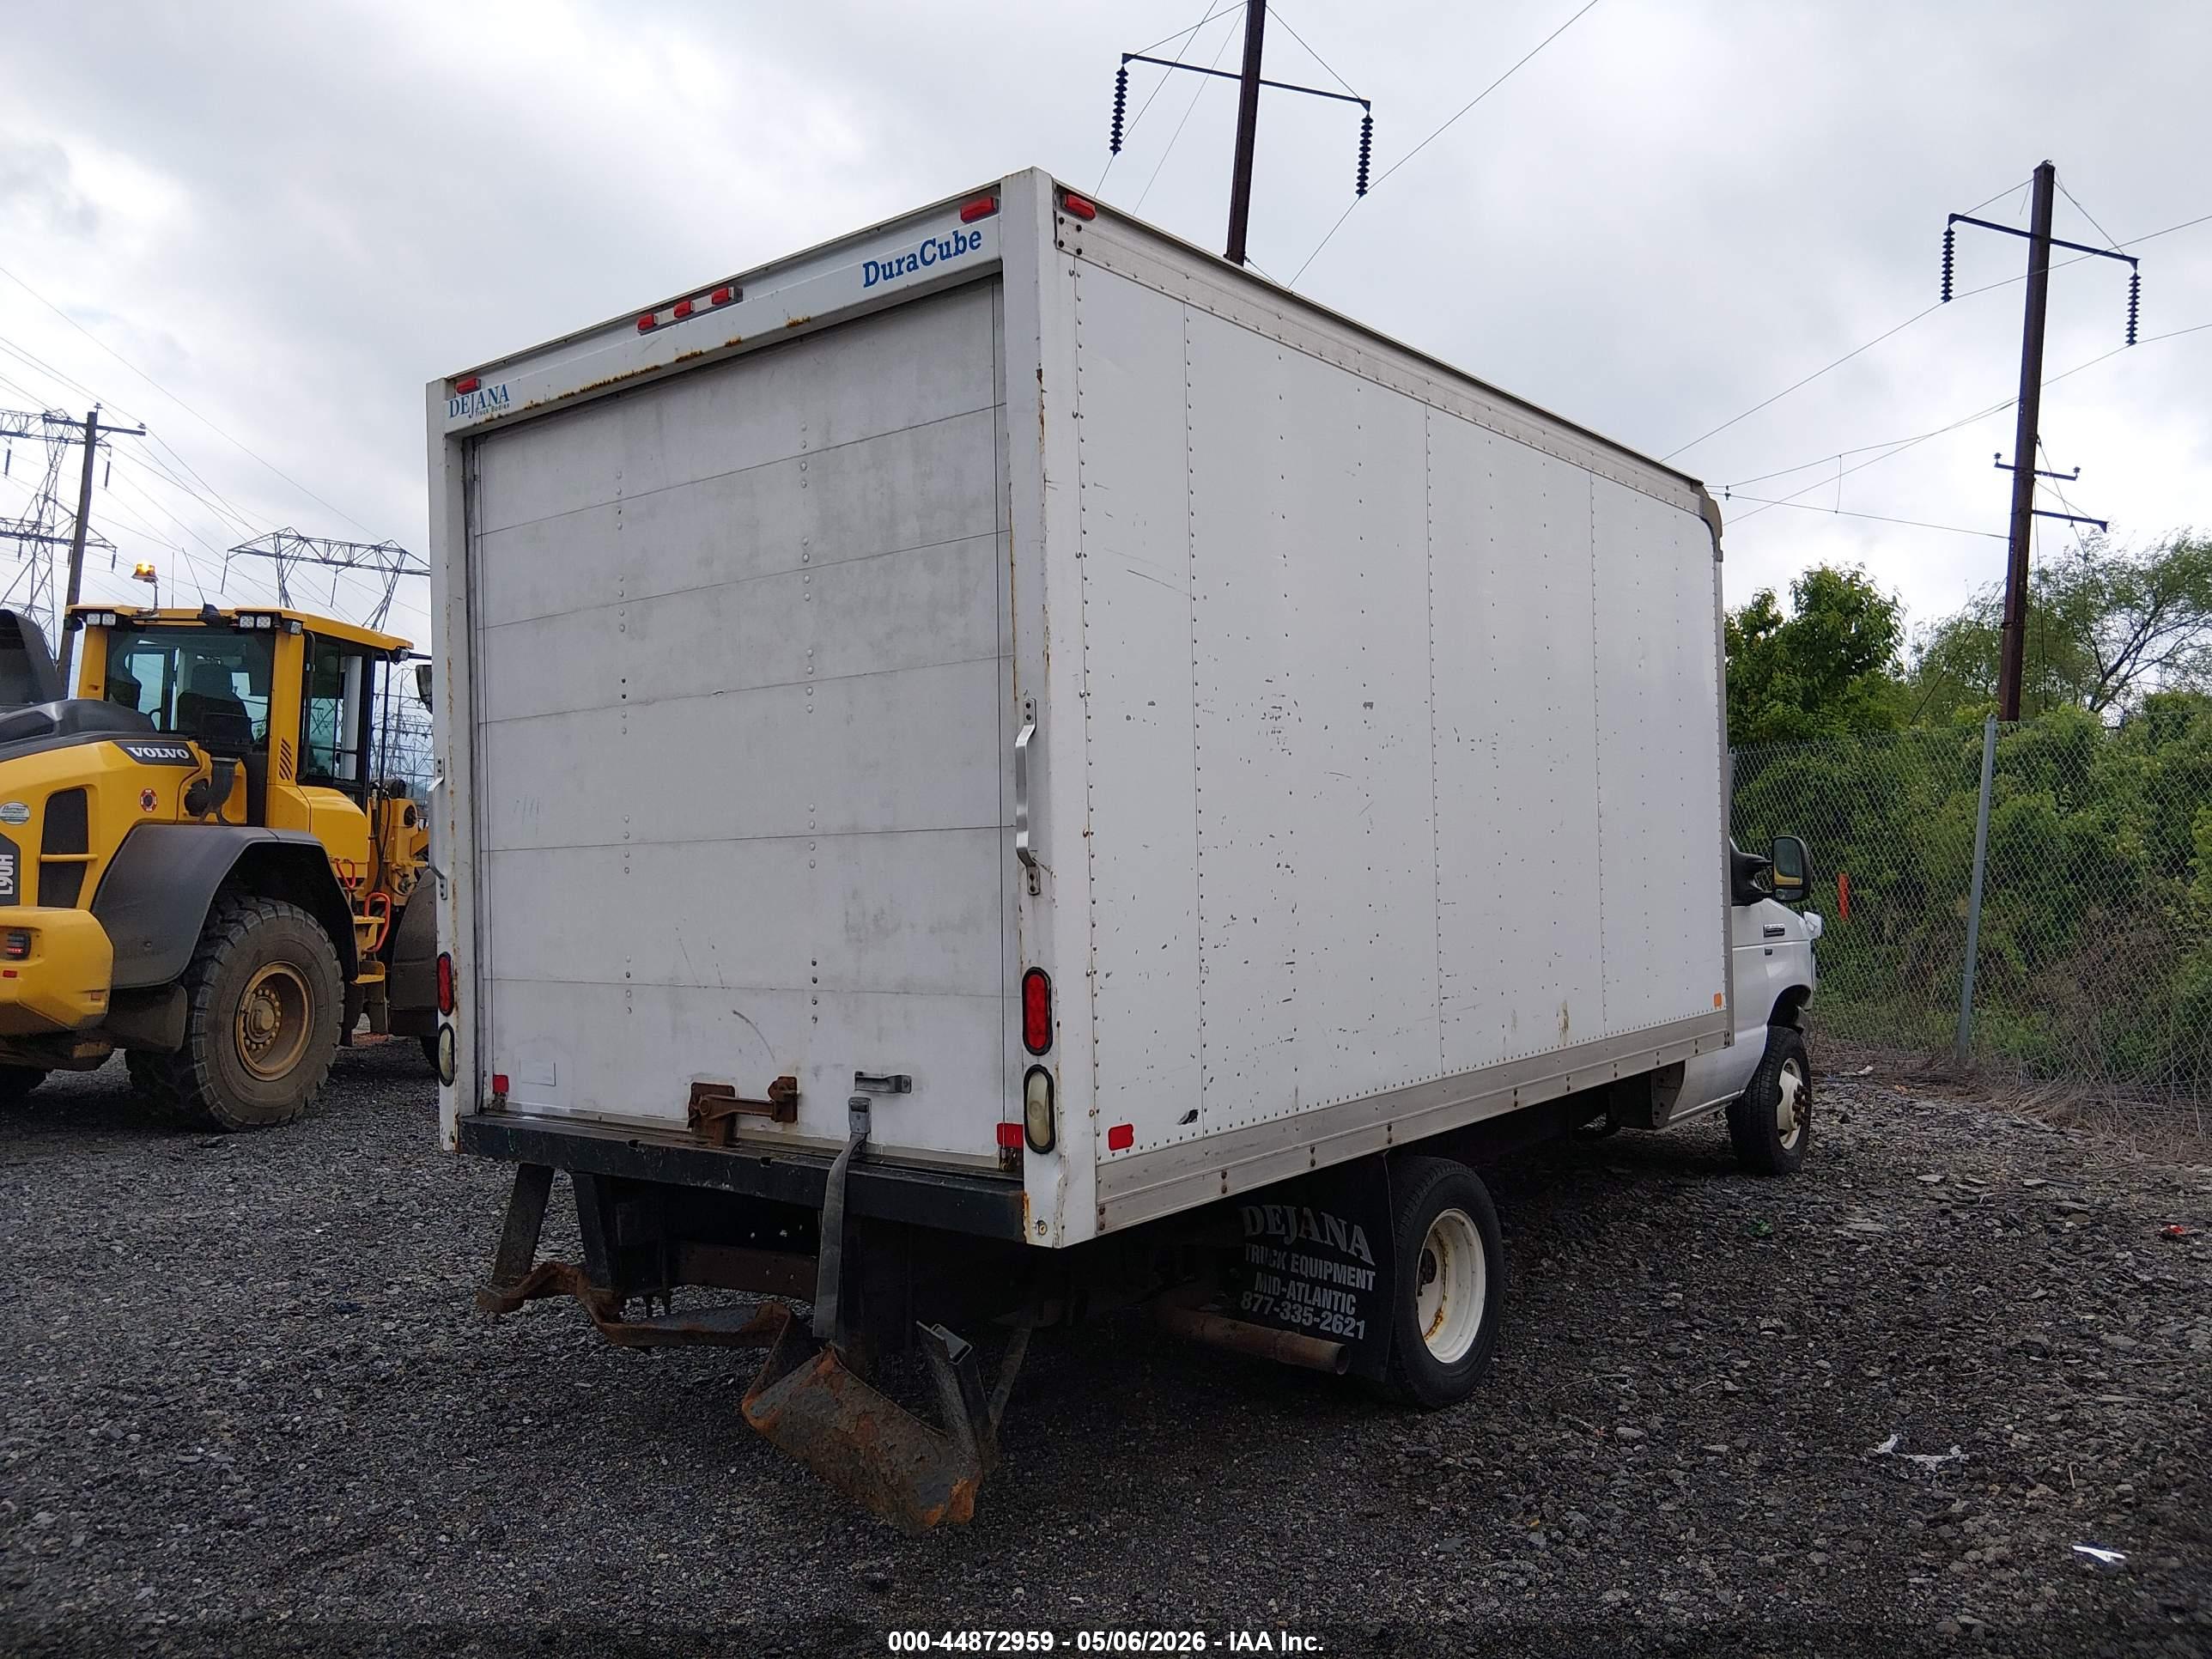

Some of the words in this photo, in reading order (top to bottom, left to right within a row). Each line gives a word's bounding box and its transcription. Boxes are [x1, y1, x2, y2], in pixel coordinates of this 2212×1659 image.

[862, 229, 982, 288] DuraCube
[449, 384, 510, 418] DEJANA
[126, 746, 190, 759] VOLVO
[1239, 1204, 1376, 1267] DEJANA
[1255, 1271, 1357, 1316] MID-ATLANTIC
[1291, 1253, 1376, 1291] EQUIPMENT
[1240, 1291, 1366, 1340] 877-335-2621
